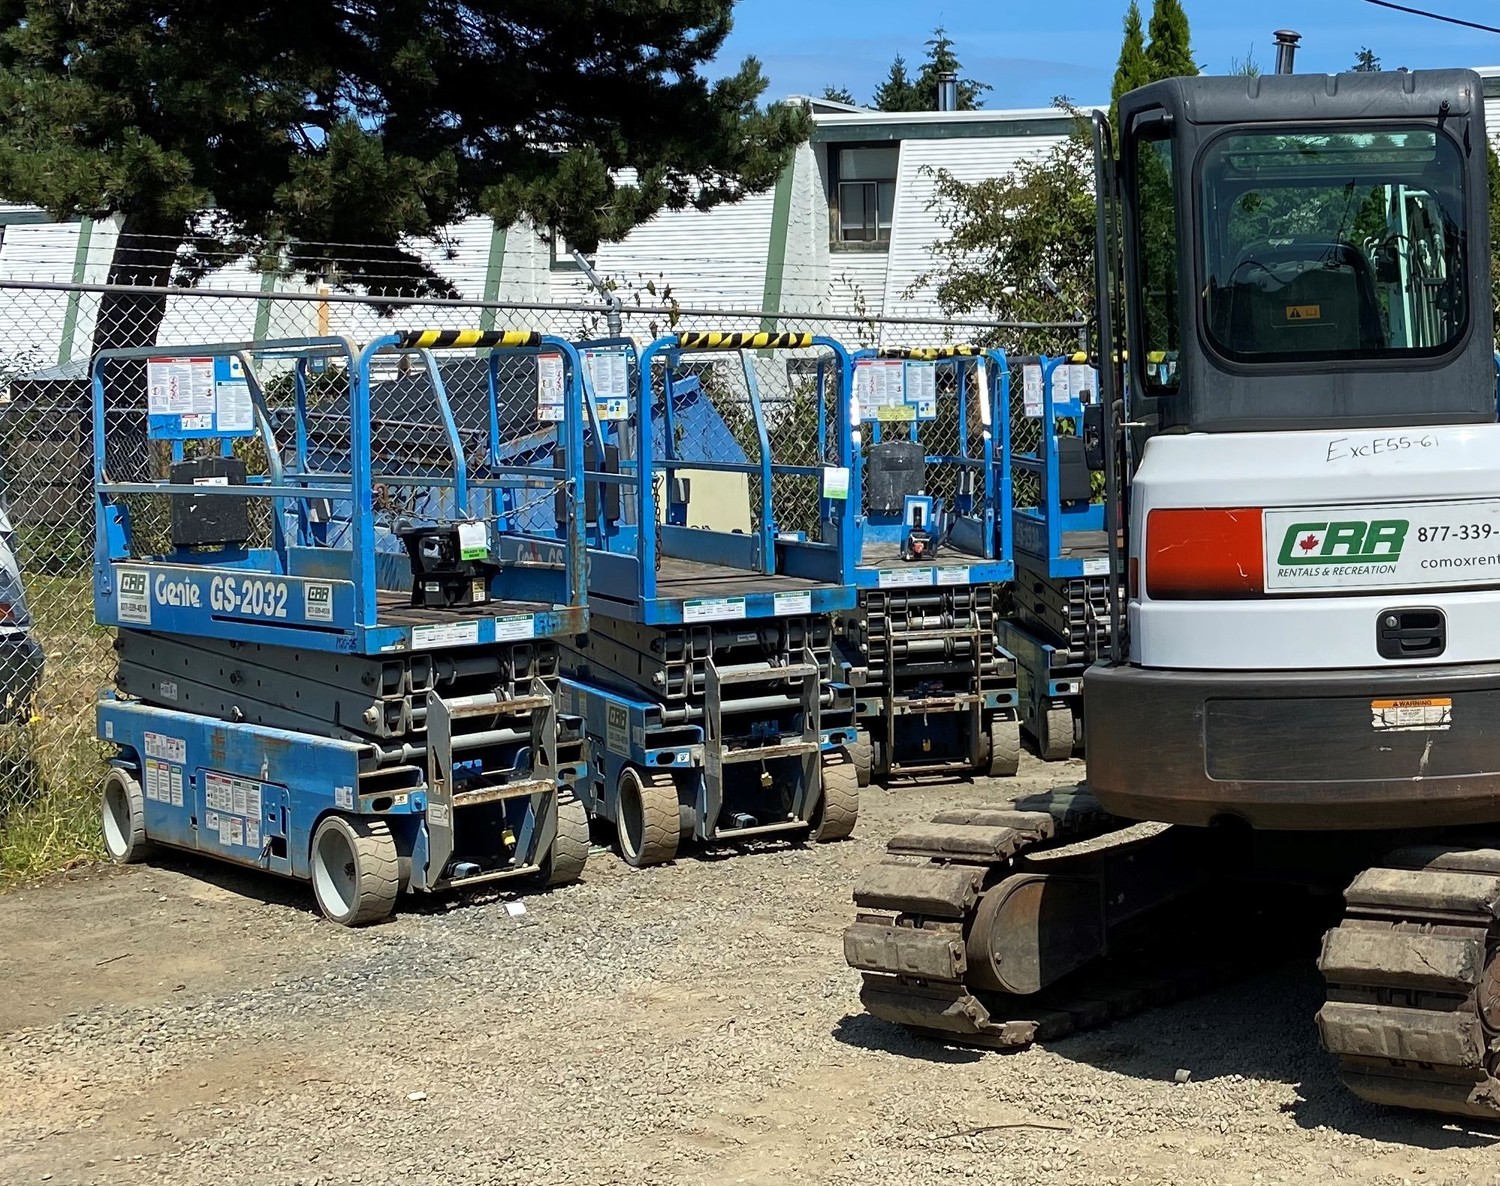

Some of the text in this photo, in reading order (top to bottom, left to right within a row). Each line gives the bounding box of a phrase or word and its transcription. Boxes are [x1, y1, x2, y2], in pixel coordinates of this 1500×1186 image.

[1277, 519, 1410, 566] CRR
[1277, 564, 1397, 578] RENTALS & RECREATION
[154, 573, 288, 618] Genie GS-2032
